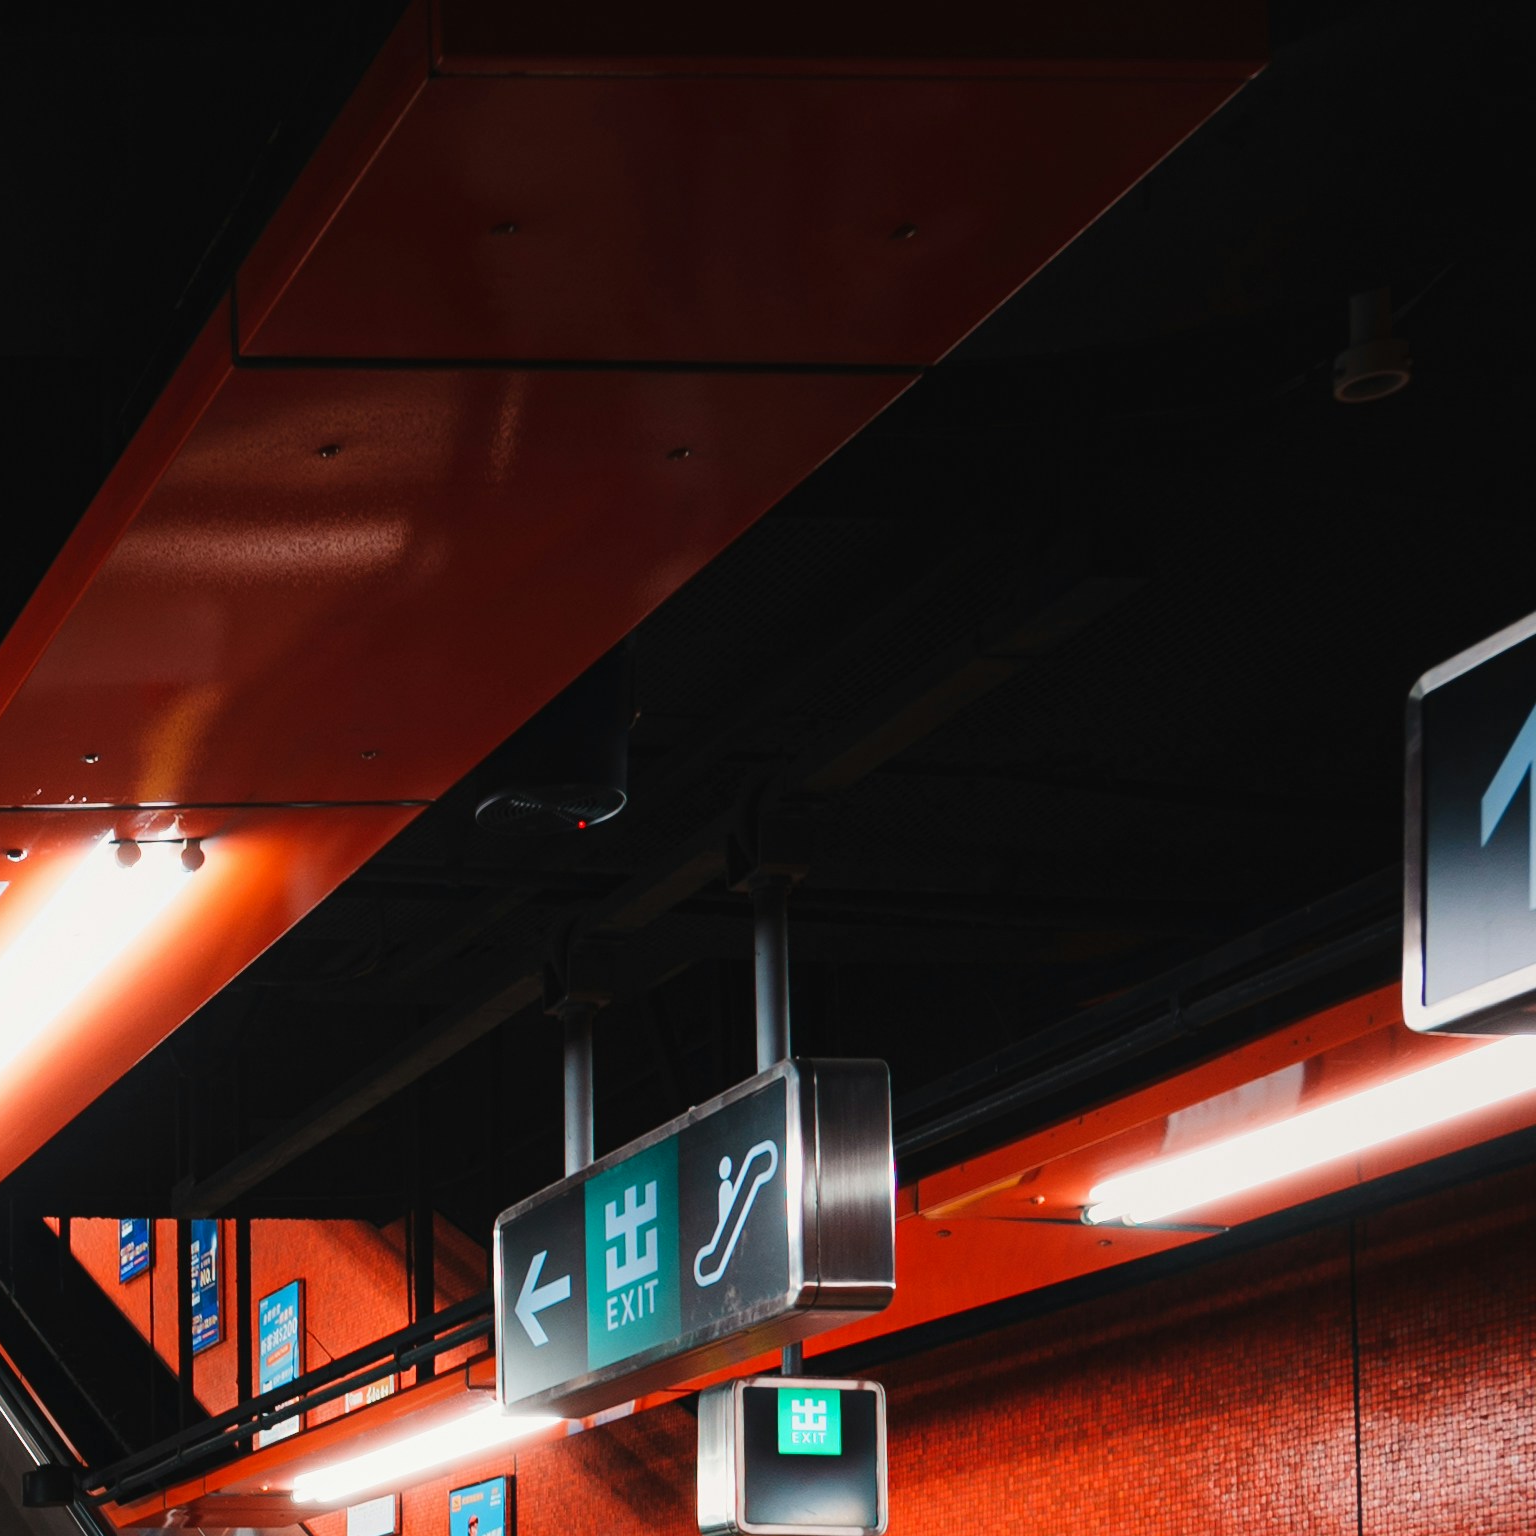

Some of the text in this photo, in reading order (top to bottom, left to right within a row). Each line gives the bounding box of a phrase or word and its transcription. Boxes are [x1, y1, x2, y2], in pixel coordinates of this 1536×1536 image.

[605, 1180, 659, 1293] 出
[607, 1278, 659, 1332] EXIT
[791, 1398, 827, 1431] 出
[791, 1431, 827, 1444] EXIT
